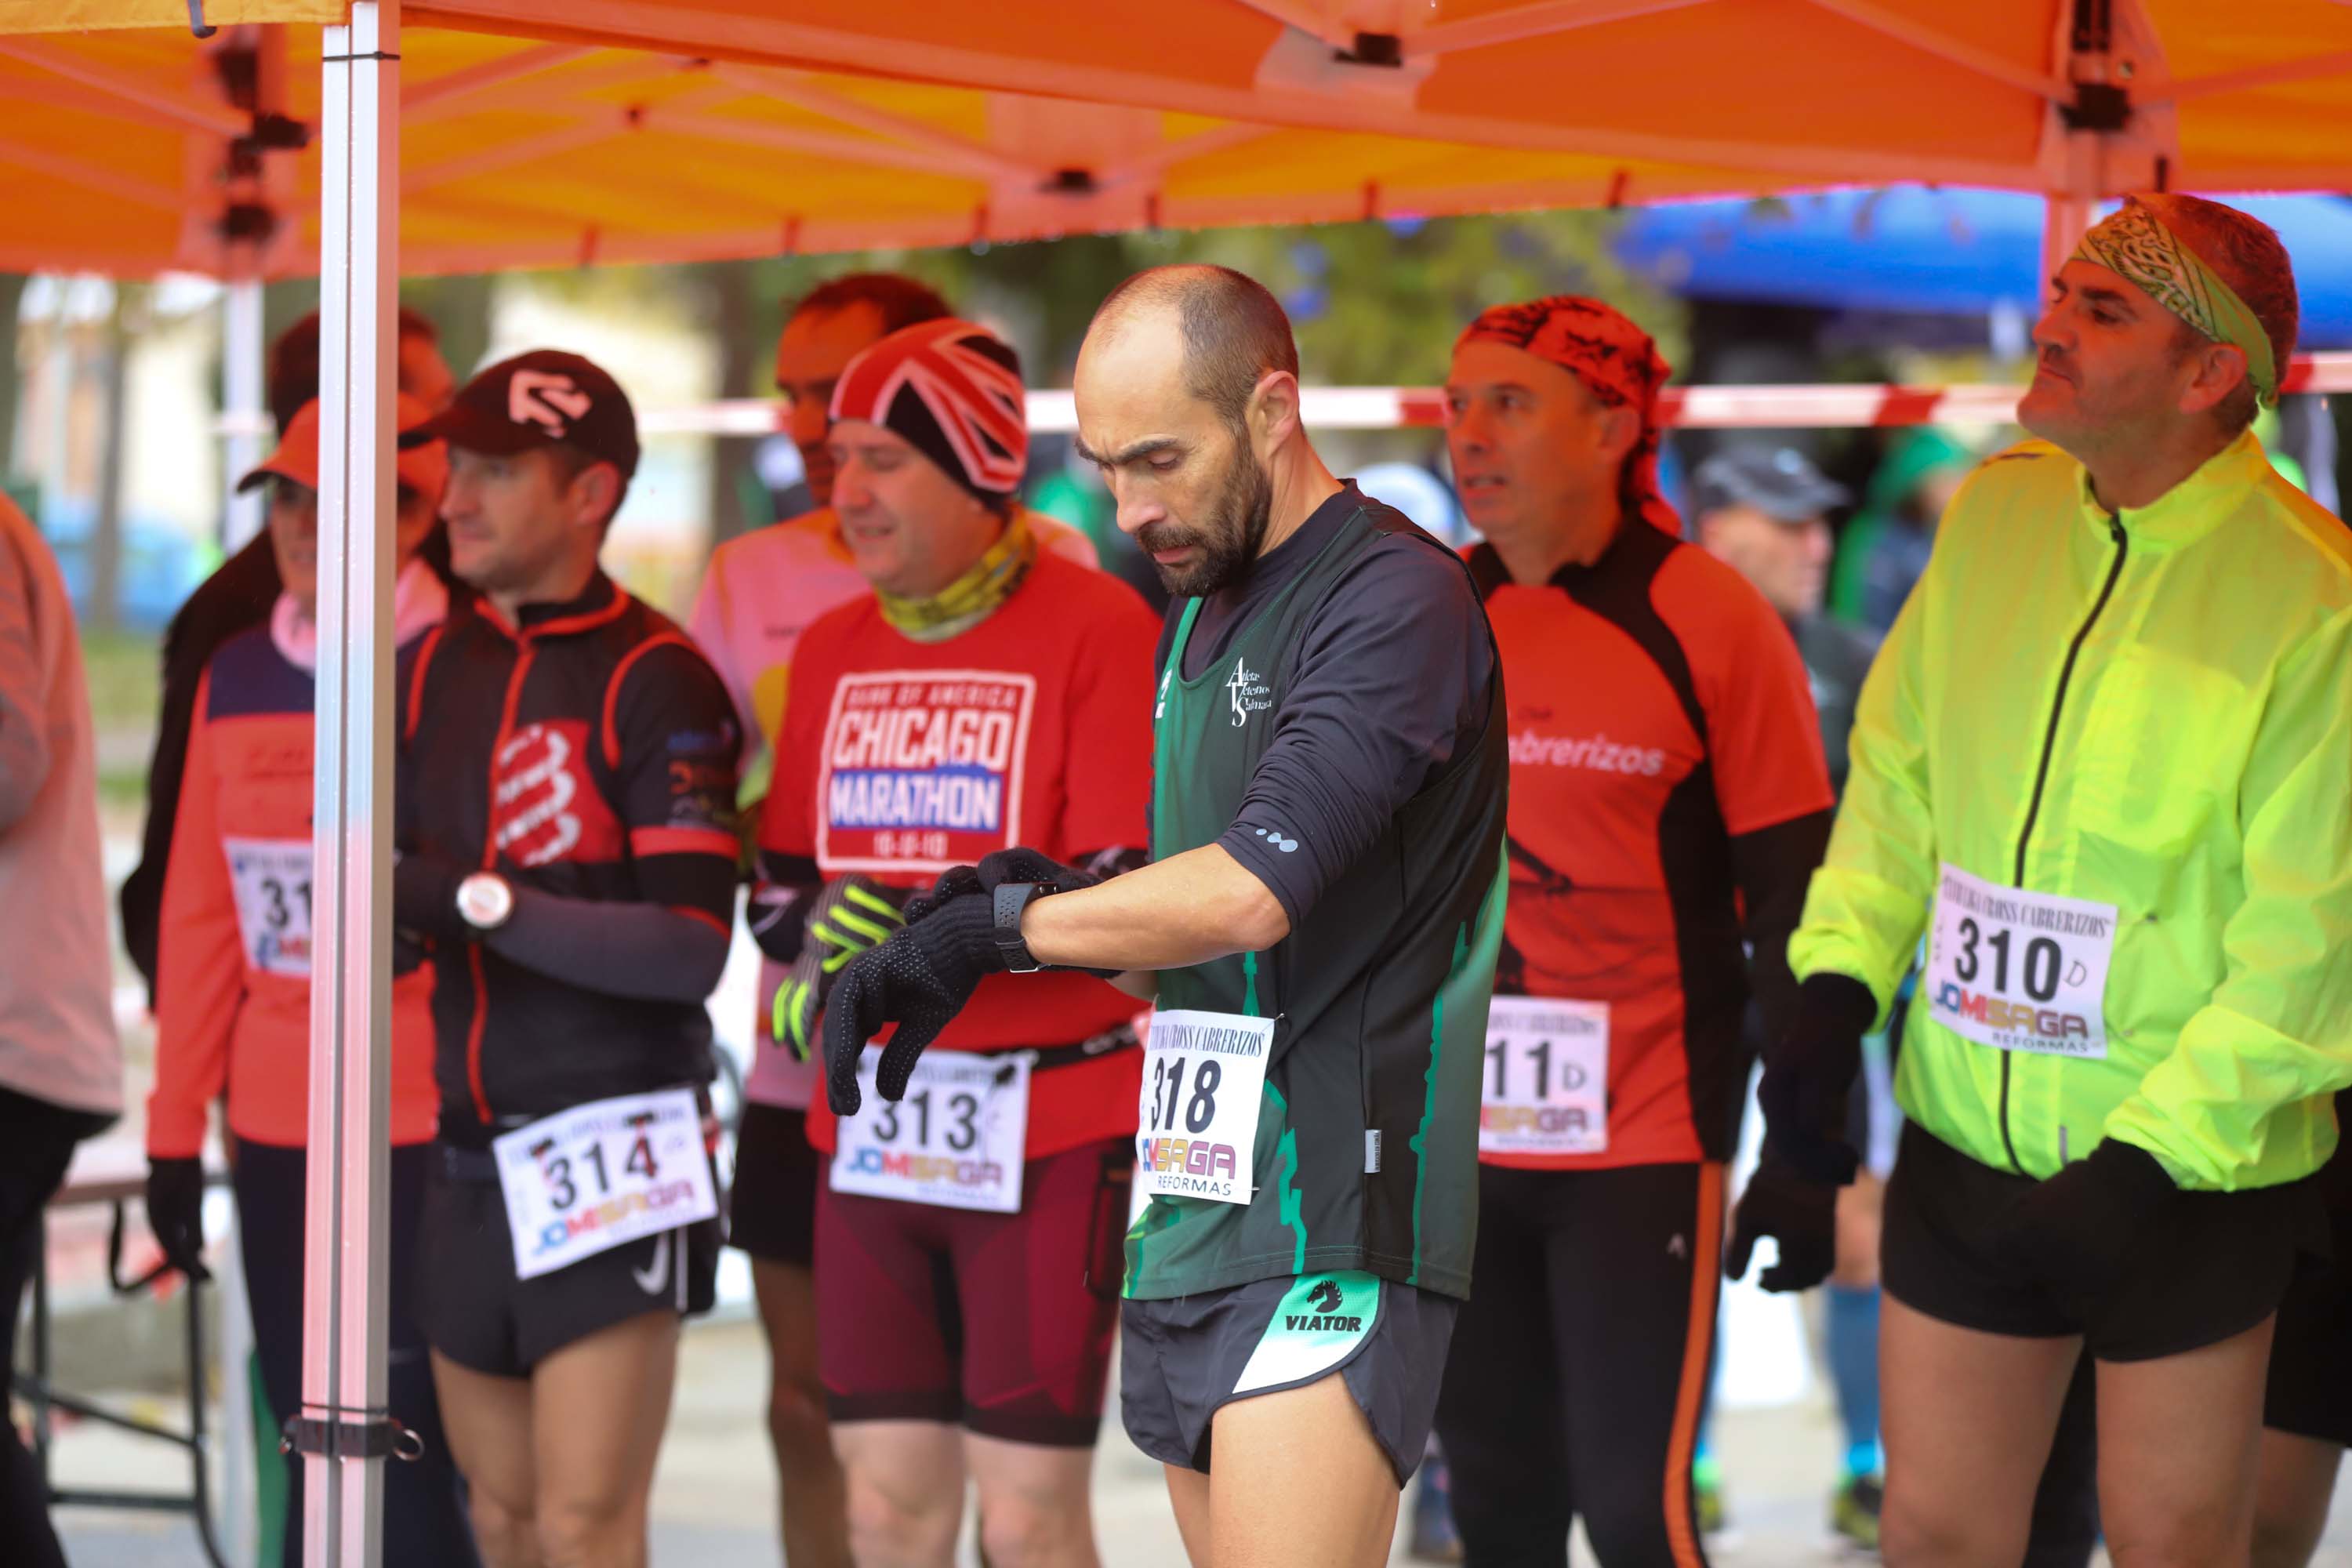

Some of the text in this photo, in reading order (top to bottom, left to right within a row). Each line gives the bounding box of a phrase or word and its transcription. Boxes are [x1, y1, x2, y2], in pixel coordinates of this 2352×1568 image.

[833, 709, 1014, 771] CHICAGO
[830, 775, 999, 828] MARATHON
[1955, 916, 2062, 1003] 310
[2063, 960, 2087, 988] D
[1935, 980, 2089, 1039] JOMISAGA
[1195, 1027, 1265, 1058] CABRERIZOS
[1993, 1032, 2088, 1052] REFORMAS
[1151, 1057, 1221, 1134] 318
[1562, 1062, 1588, 1091] D
[873, 1088, 978, 1151] 313
[547, 1138, 659, 1210] 314
[847, 1146, 1003, 1187] JOMISAGA
[1157, 1174, 1232, 1196] REFORMAS
[1286, 1315, 1362, 1333] VIATOR
